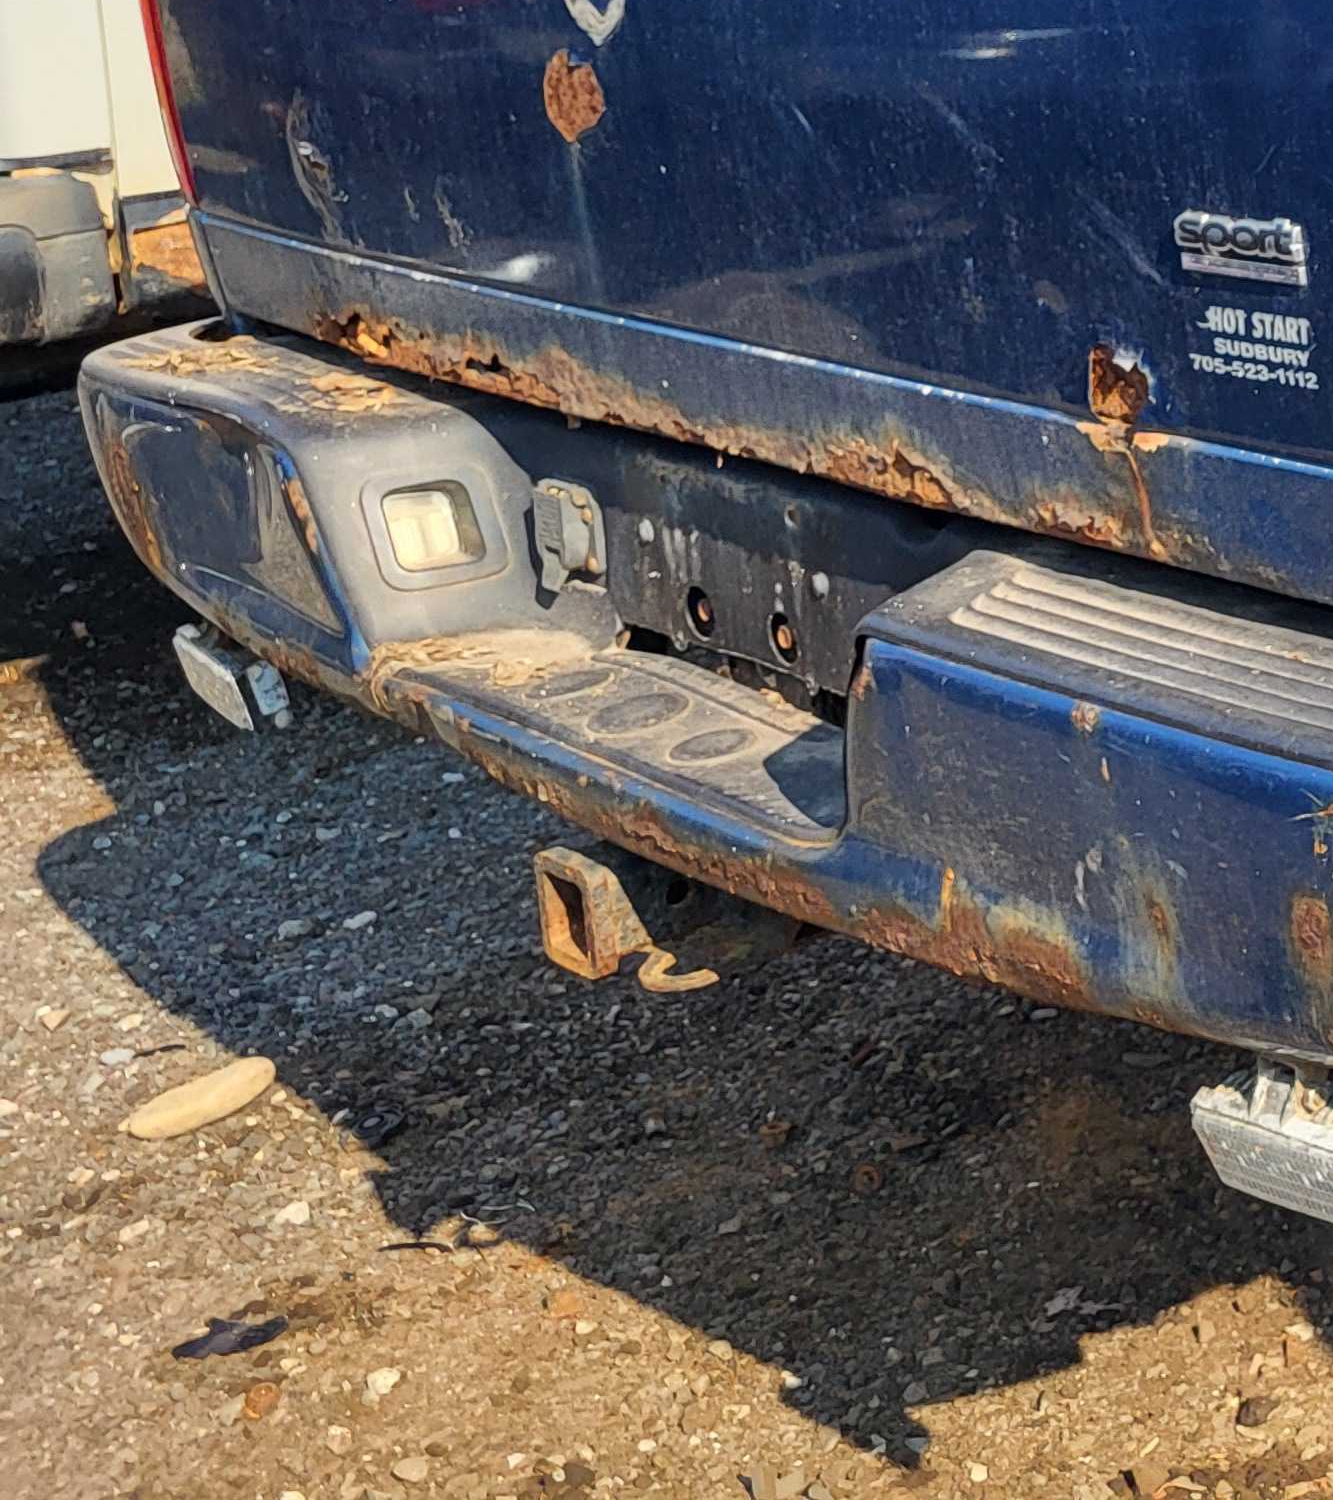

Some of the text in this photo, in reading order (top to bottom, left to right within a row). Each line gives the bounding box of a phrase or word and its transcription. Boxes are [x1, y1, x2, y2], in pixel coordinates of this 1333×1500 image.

[1204, 305, 1312, 346] HOT START
[1187, 352, 1320, 391] 705-523-1112
[1212, 336, 1311, 368] SUDBURY
